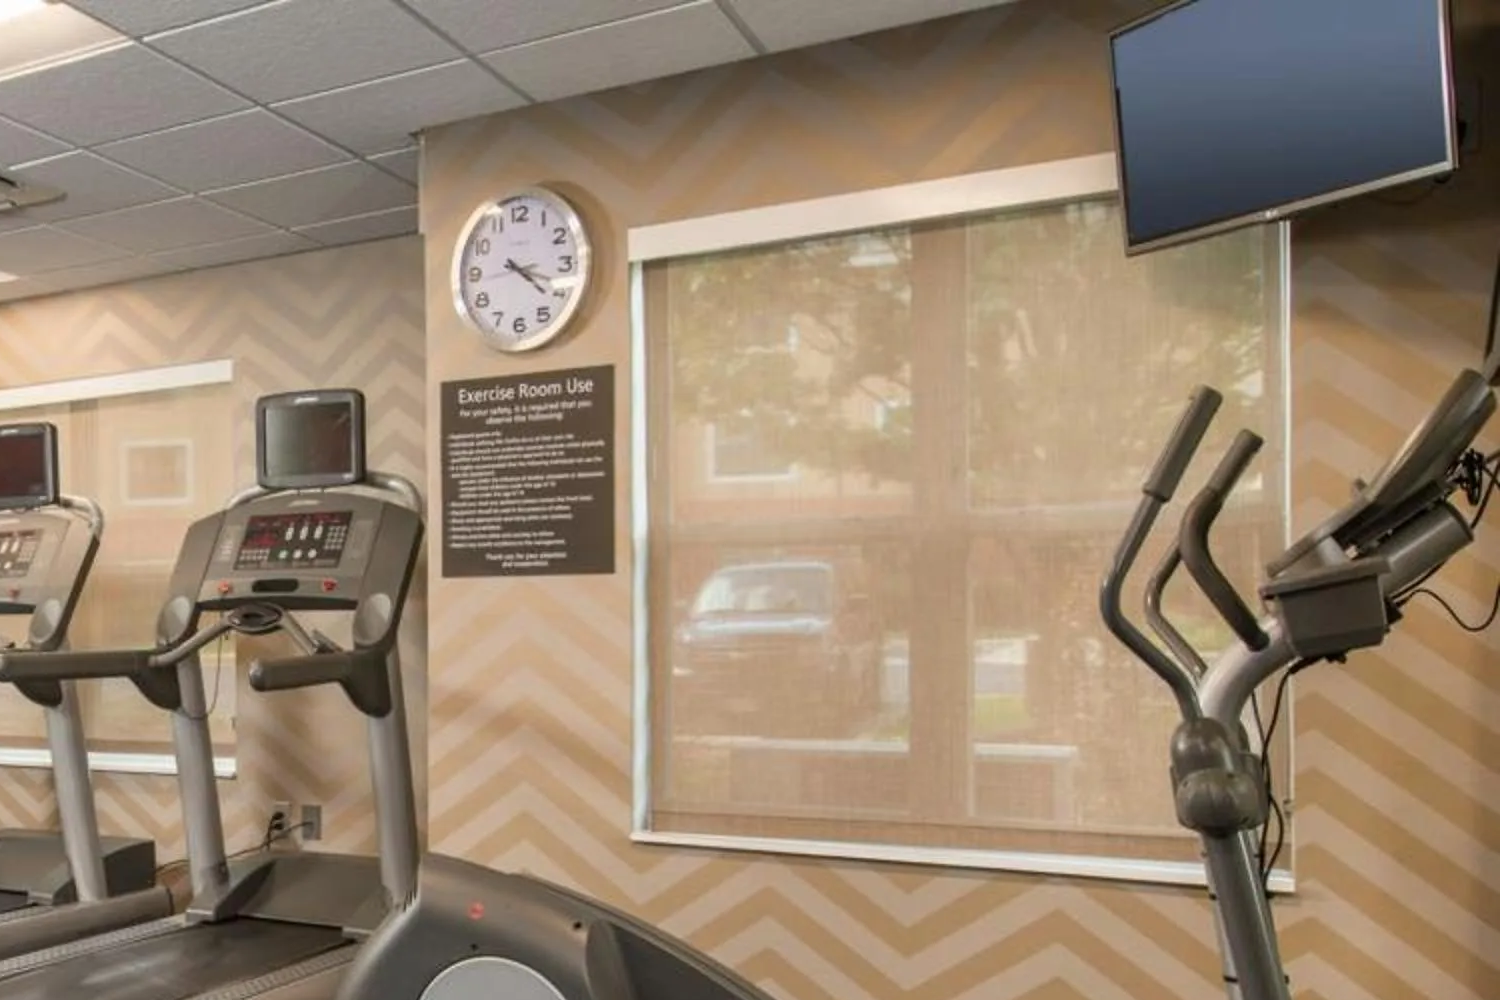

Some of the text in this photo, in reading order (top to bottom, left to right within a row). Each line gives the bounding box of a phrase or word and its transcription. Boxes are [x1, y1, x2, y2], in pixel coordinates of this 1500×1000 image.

[511, 205, 529, 224] 12
[541, 209, 547, 227] 1
[491, 215, 504, 233] 11
[552, 227, 567, 245] 2
[475, 238, 490, 256] 10
[557, 255, 573, 273] 3
[468, 266, 483, 283] 9
[475, 291, 490, 309] 8
[491, 310, 504, 327] 7
[536, 306, 551, 323] 5
[512, 316, 527, 333] 6
[458, 377, 594, 404] Exercise Room Use
